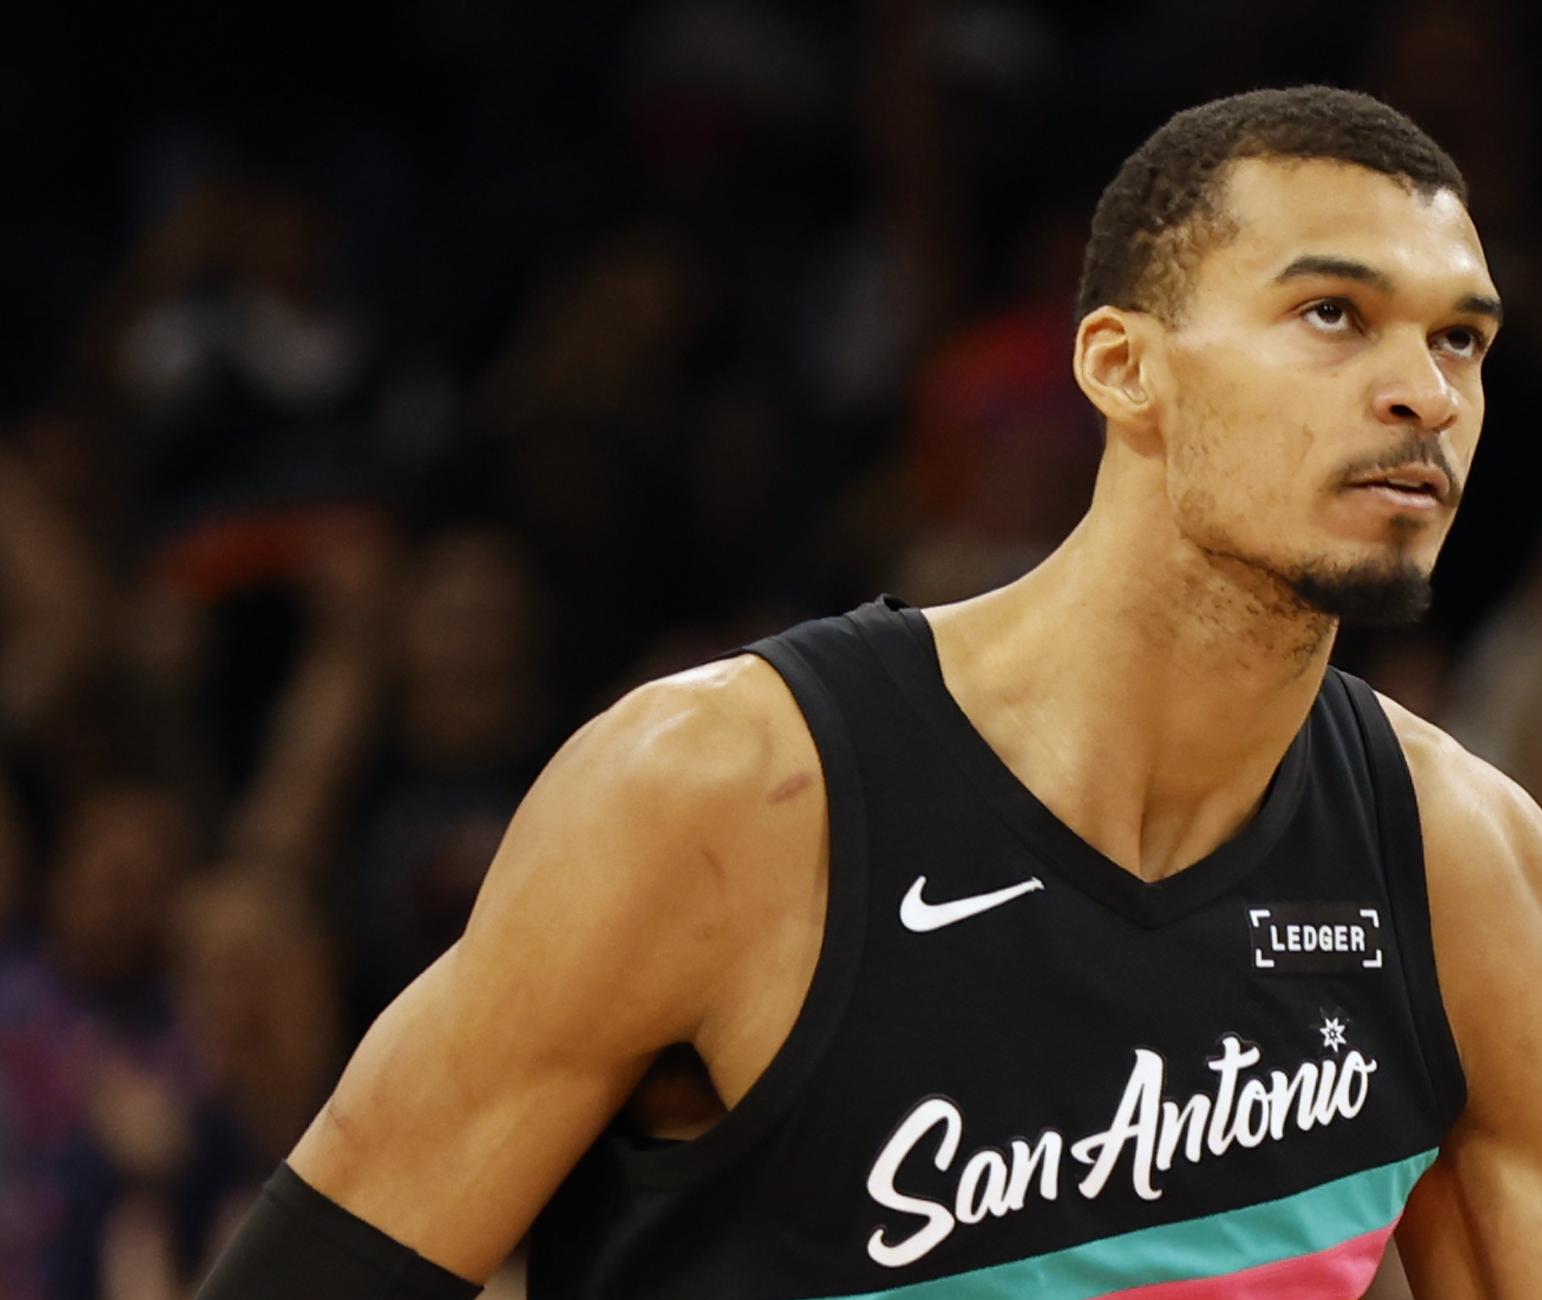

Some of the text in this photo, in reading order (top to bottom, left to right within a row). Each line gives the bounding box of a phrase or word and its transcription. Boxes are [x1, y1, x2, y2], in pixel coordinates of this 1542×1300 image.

[1270, 924, 1366, 952] LEDGER
[866, 1018, 1378, 1268] San Antonio
